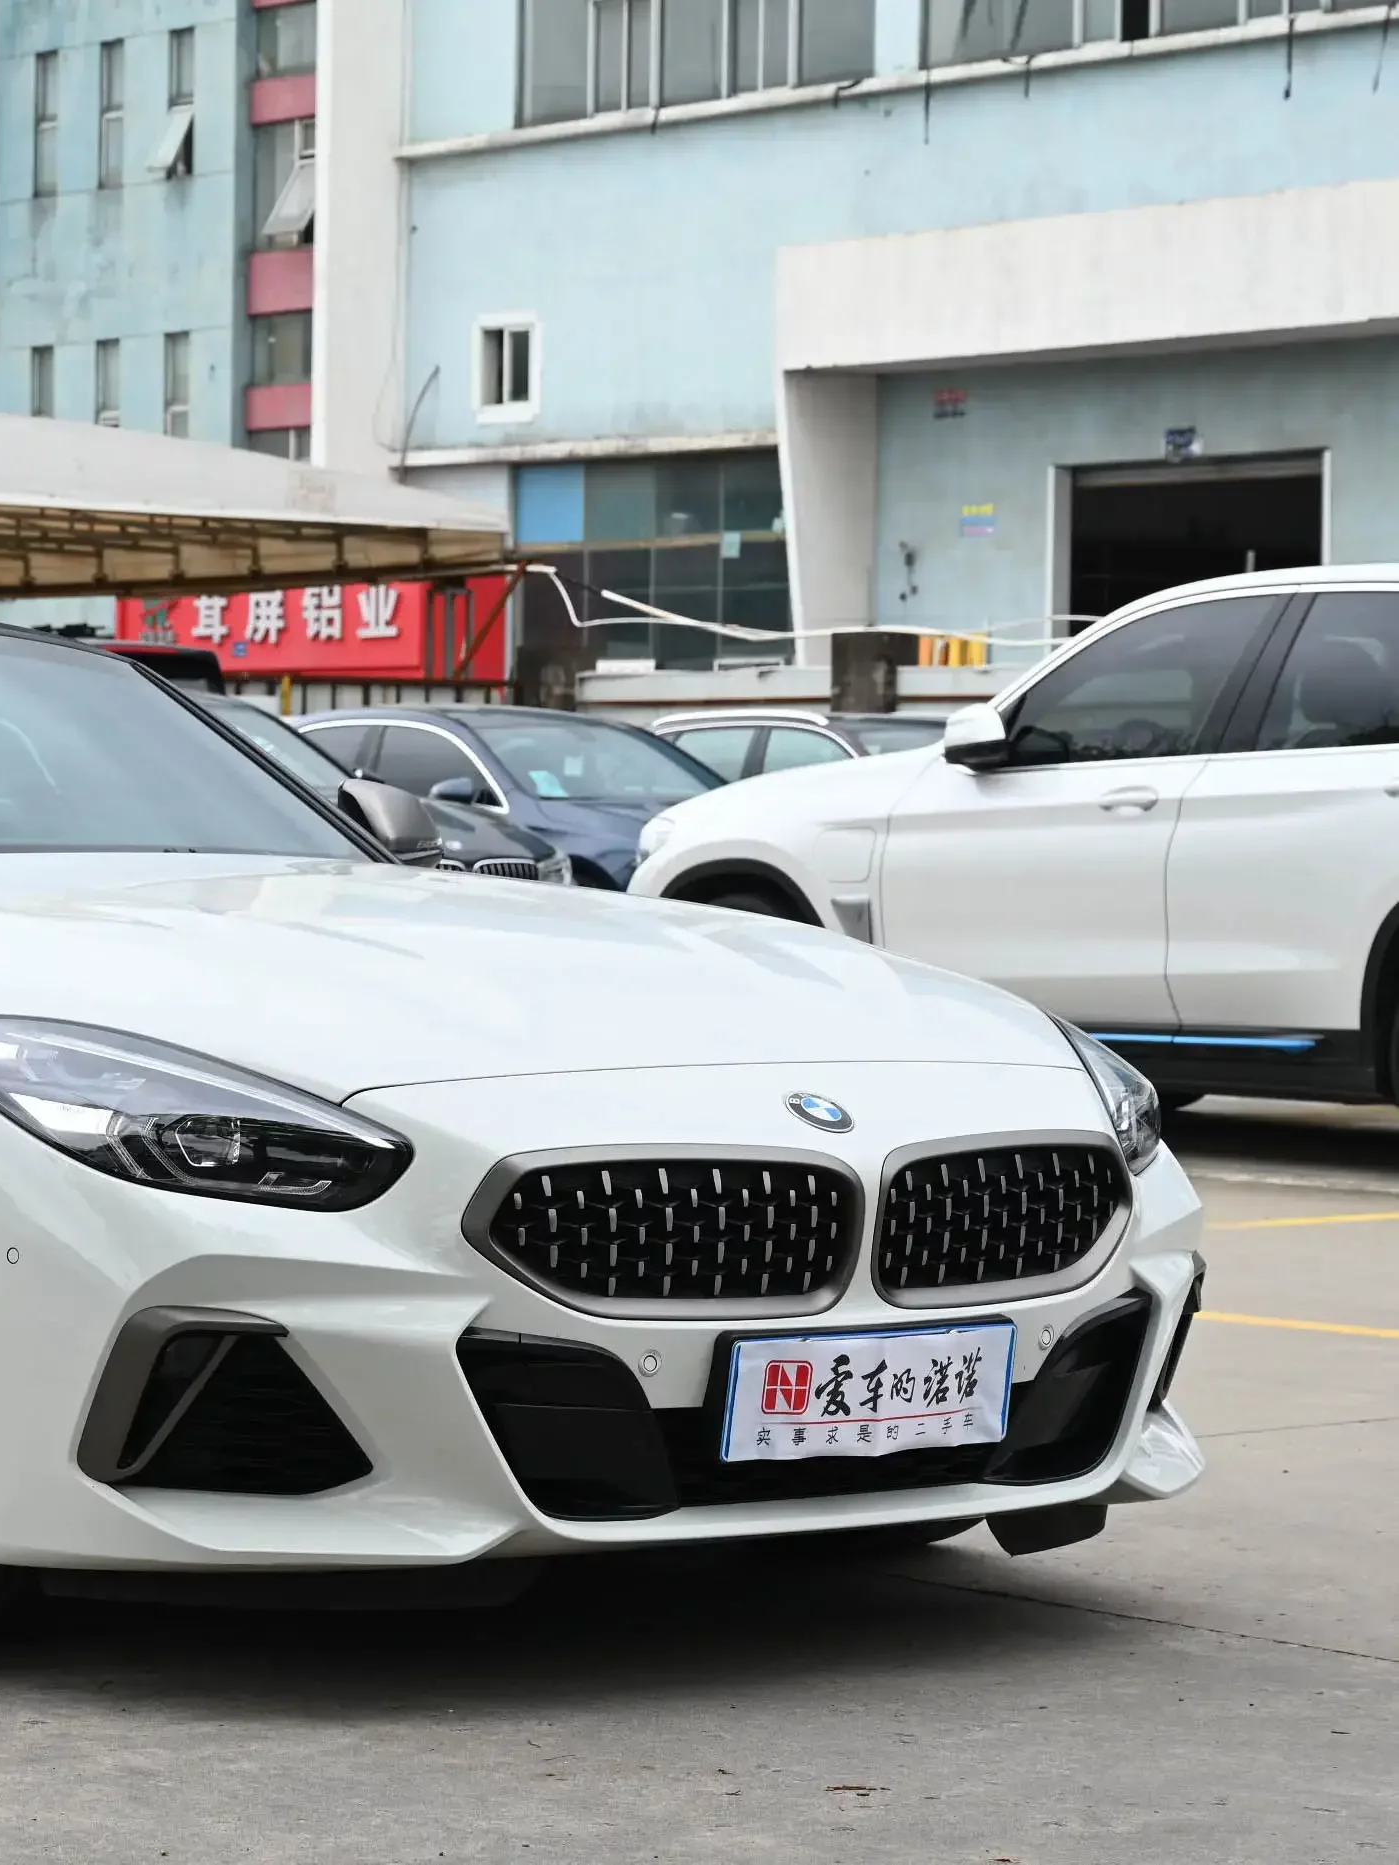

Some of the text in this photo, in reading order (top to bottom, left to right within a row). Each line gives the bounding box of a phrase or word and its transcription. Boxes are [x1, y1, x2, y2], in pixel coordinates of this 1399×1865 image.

[756, 1412, 974, 1446] 实事求是的二手车
